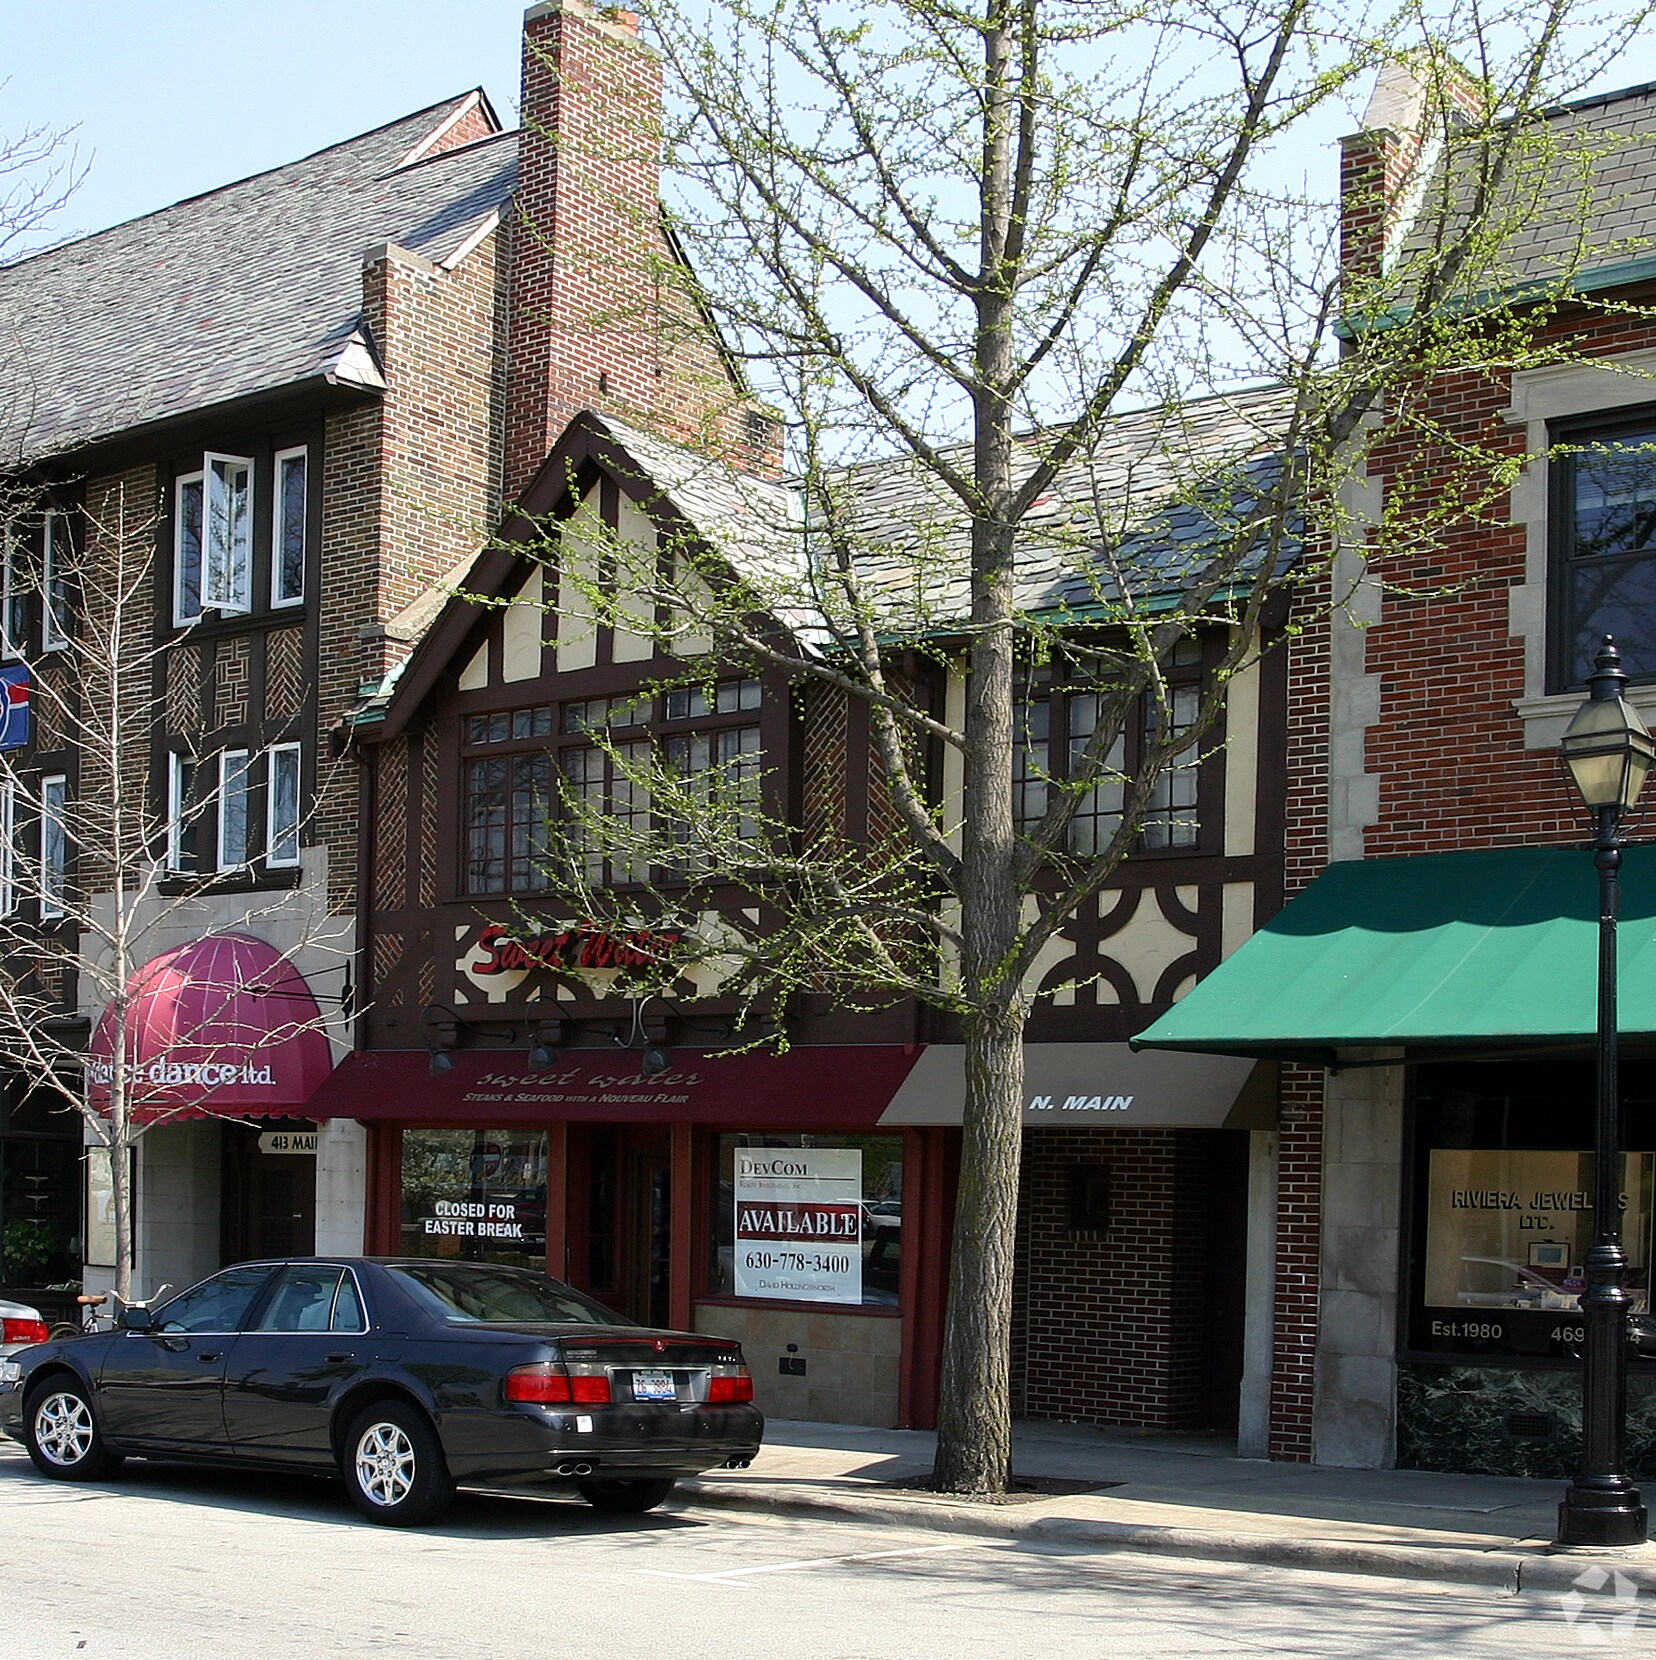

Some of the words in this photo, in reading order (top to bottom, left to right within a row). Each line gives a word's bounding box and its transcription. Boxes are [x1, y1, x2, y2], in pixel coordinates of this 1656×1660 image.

[472, 924, 570, 975] Sweet
[150, 1056, 237, 1085] dance
[240, 1064, 277, 1085] ltd.
[476, 1067, 581, 1088] sweet
[589, 1066, 704, 1088] water
[503, 1093, 512, 1101] &
[654, 1094, 690, 1104] FLAIR
[1028, 1095, 1055, 1110] N.
[1062, 1095, 1134, 1110] MAIN
[271, 1135, 289, 1150] 413
[1452, 1190, 1521, 1210] RIVIERA
[1530, 1191, 1629, 1211] JEWELS
[435, 1201, 485, 1218] CLOSED
[488, 1203, 515, 1219] FOR
[425, 1220, 474, 1236] EASTER
[478, 1222, 523, 1238] BREAK
[739, 1209, 857, 1236] AVAILABLE
[1519, 1215, 1555, 1230] LTD.
[746, 1251, 849, 1273] 630-778-3400
[1431, 1321, 1502, 1339] Est.1980
